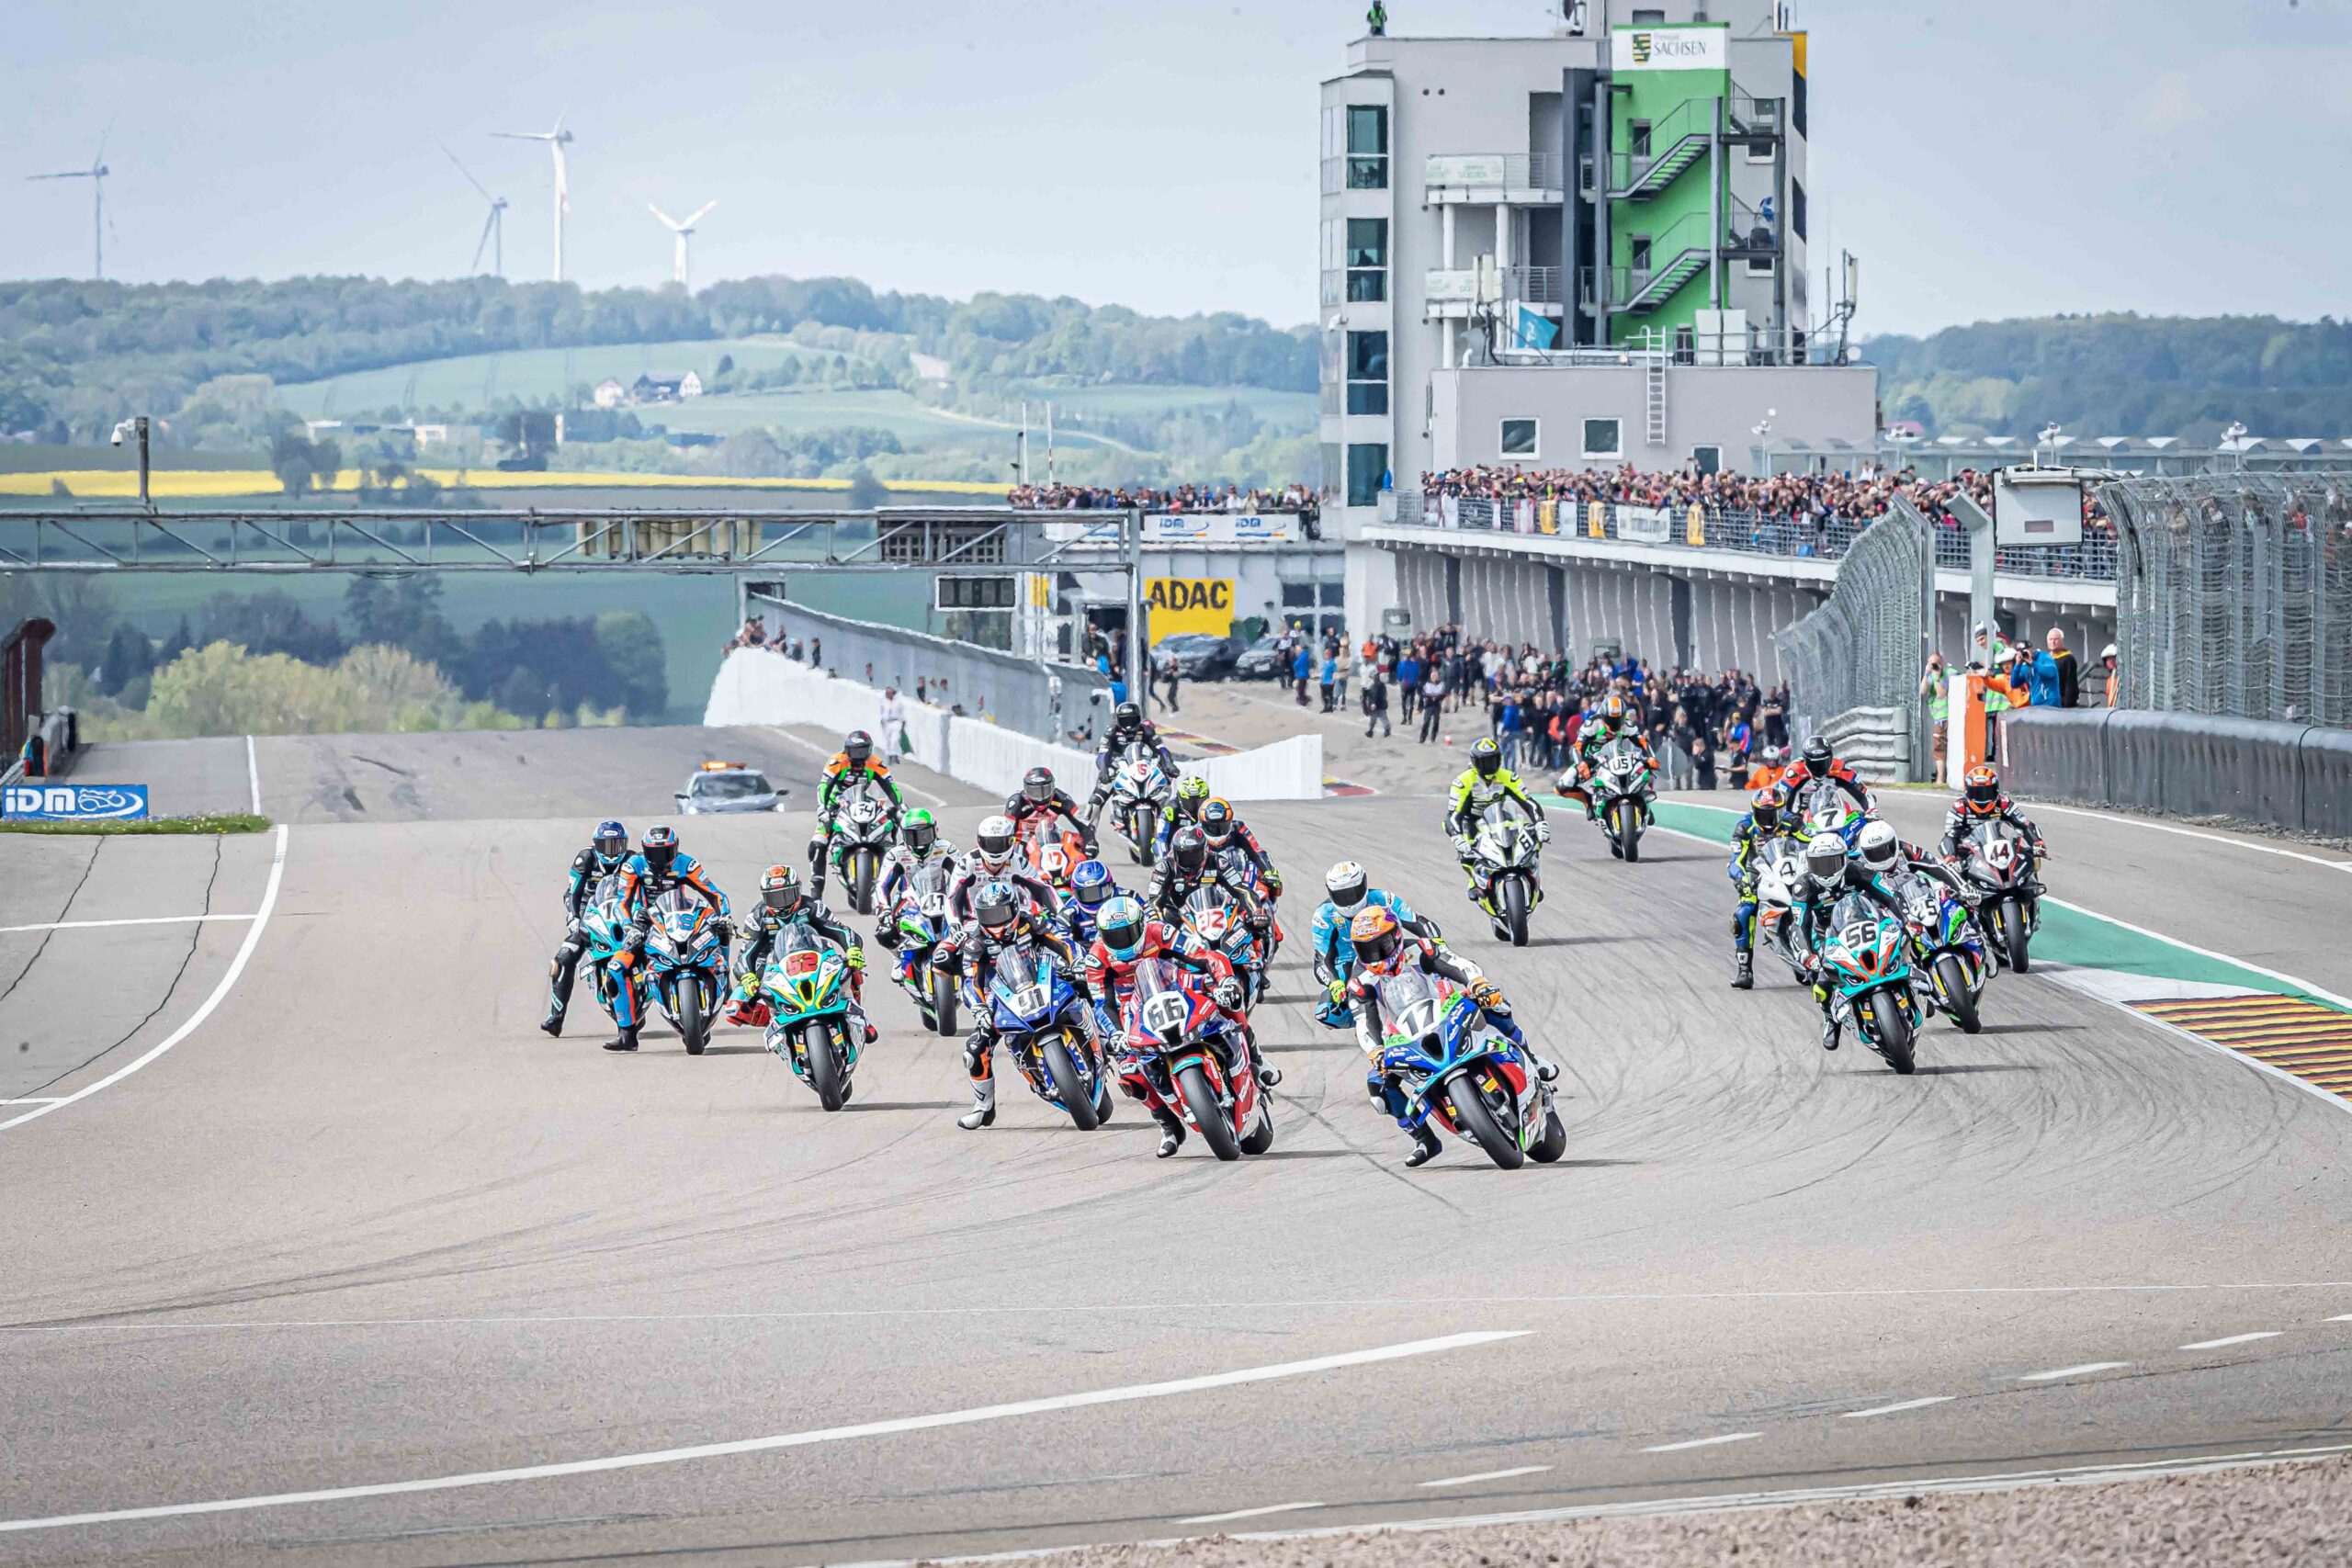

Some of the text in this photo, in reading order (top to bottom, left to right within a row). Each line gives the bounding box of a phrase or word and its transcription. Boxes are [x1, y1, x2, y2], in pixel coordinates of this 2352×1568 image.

[1654, 41, 1706, 56] SACHSEN
[1148, 580, 1228, 612] ADAC
[1822, 810, 1838, 828] 7
[1990, 842, 2010, 862] 44
[922, 892, 944, 913] 41
[1846, 922, 1876, 949] 56
[786, 952, 818, 977] 52
[1018, 987, 1045, 1015] 91
[1148, 998, 1185, 1030] 66
[1402, 998, 1434, 1036] 17
